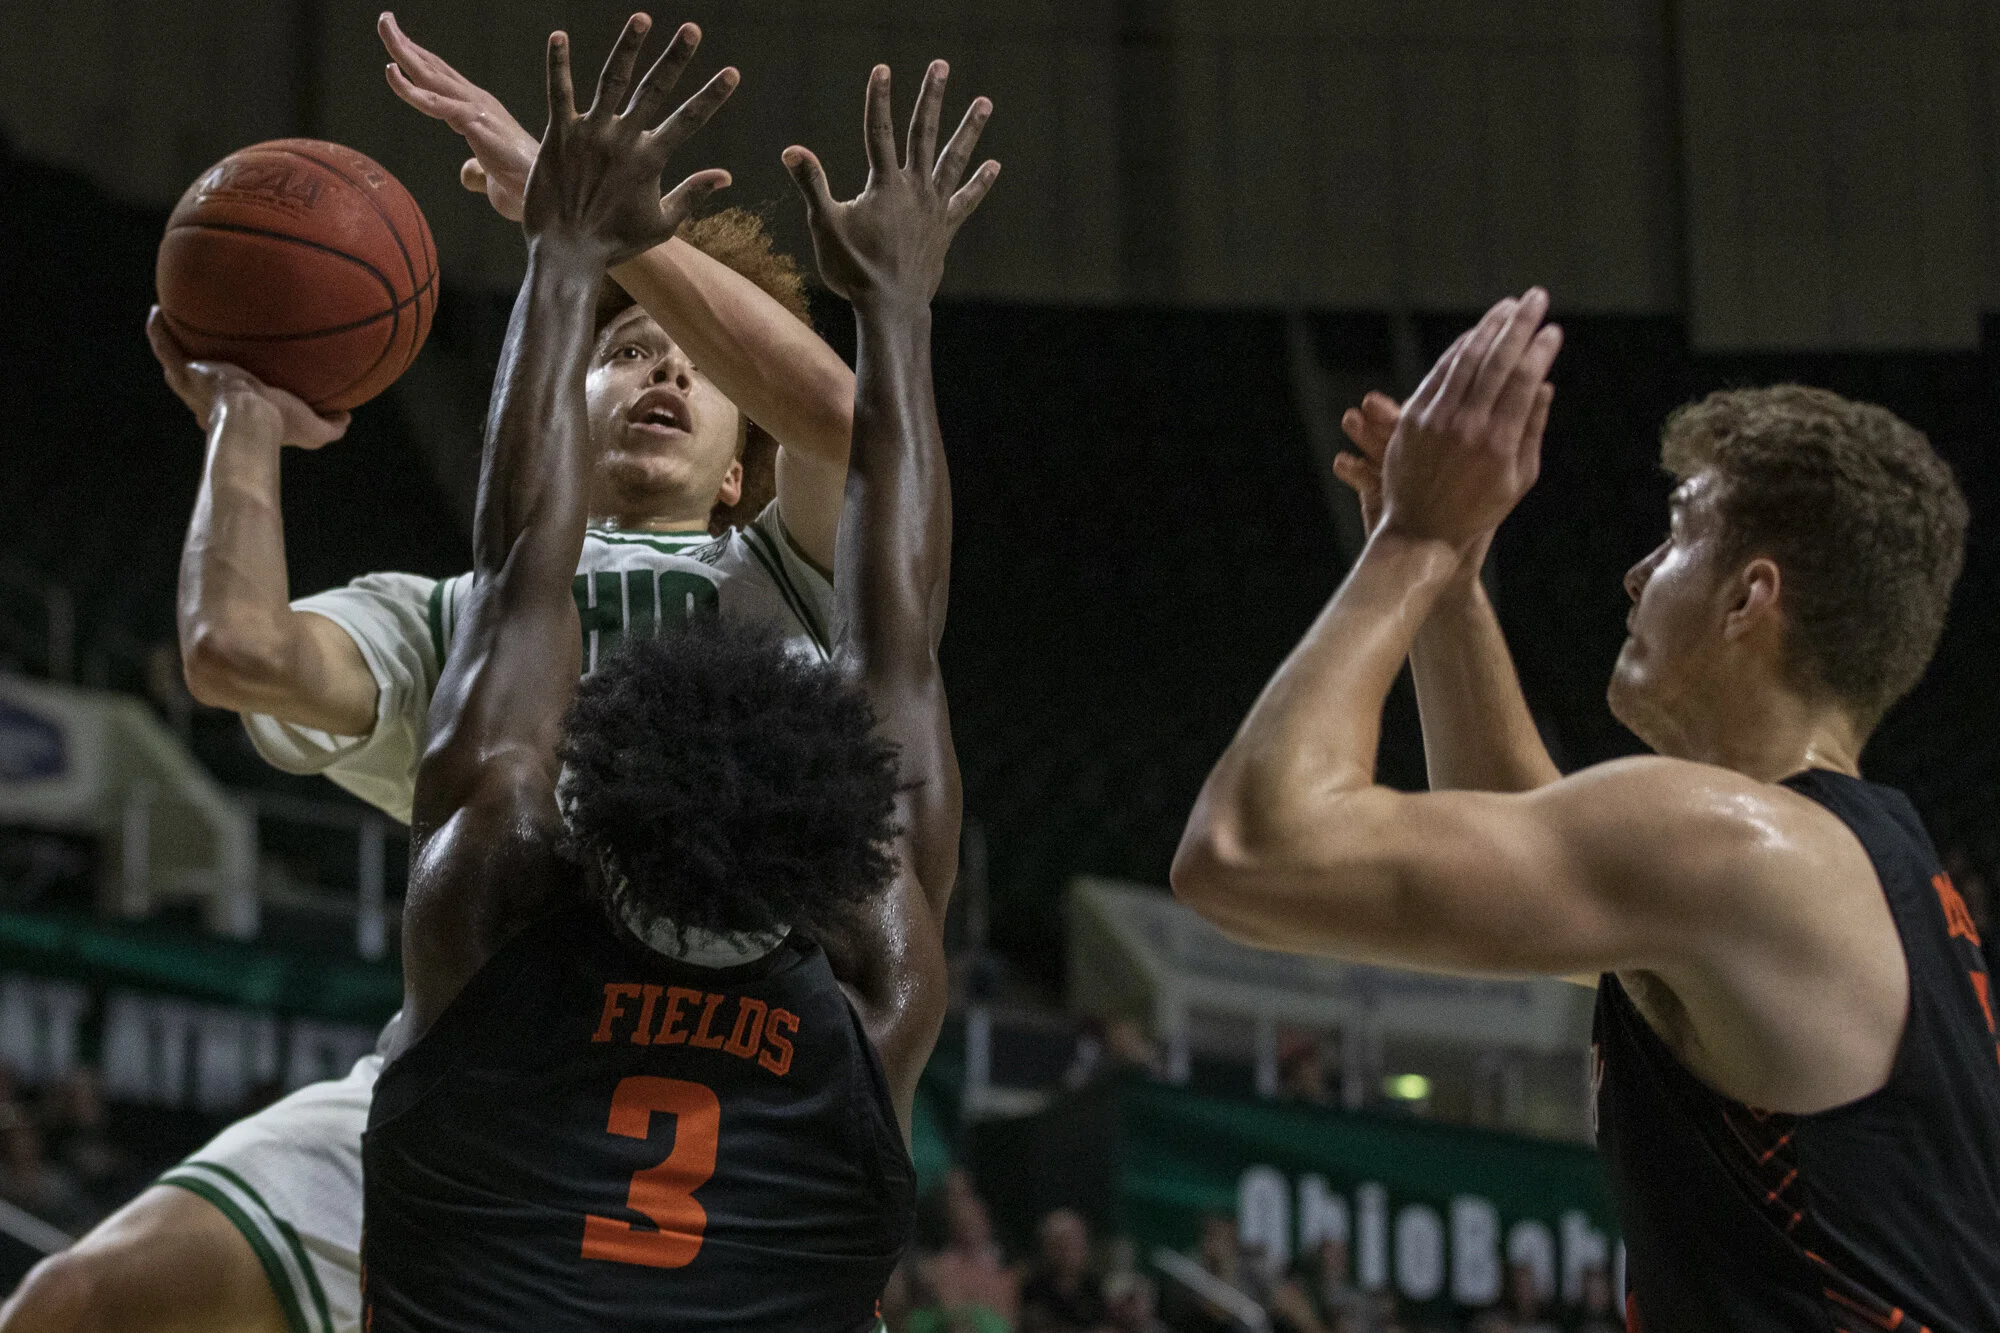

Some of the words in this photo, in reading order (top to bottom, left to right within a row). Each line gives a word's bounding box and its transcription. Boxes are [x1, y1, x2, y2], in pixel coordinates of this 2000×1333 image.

[571, 570, 720, 676] HIO
[591, 983, 801, 1076] FIELDS
[581, 1075, 721, 1269] 3
[1238, 1164, 1626, 1314] OhioBob
